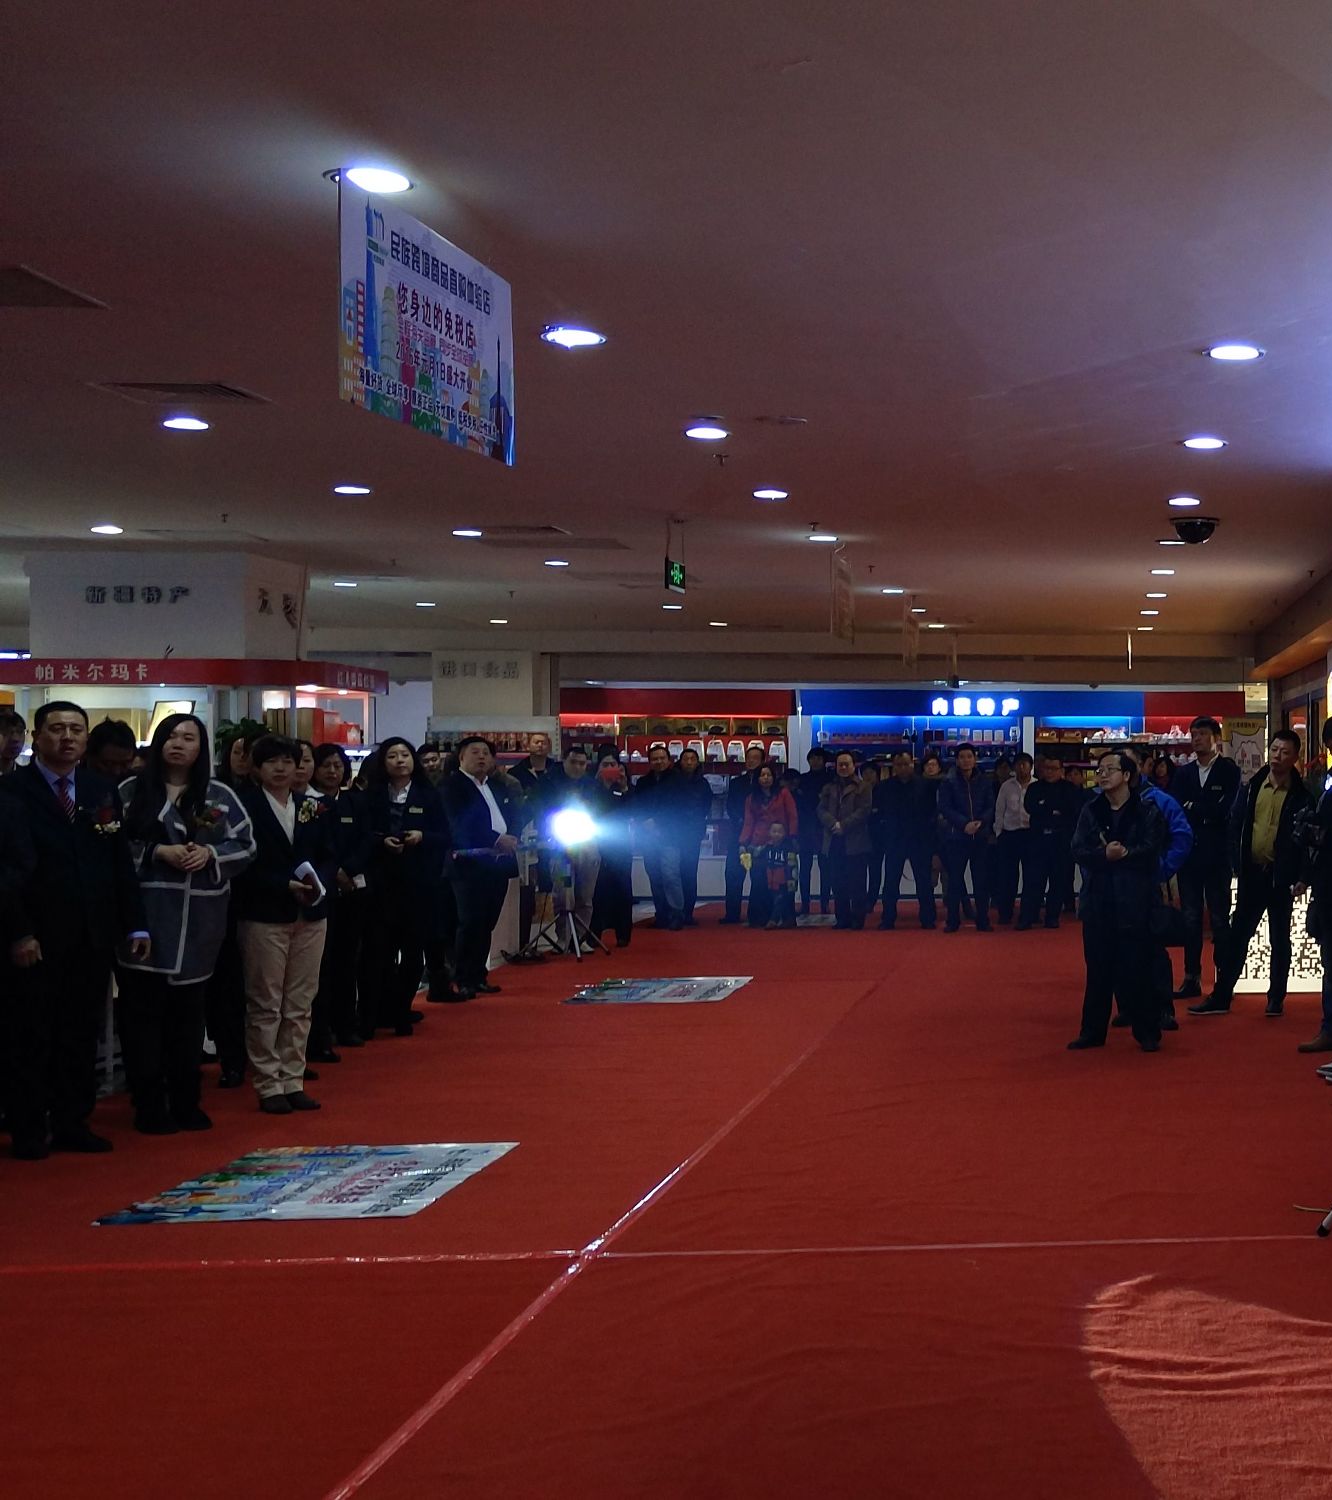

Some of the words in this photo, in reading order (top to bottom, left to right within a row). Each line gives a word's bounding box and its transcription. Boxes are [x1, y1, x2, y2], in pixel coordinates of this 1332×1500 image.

[396, 281, 475, 349] 您身边的免税店
[35, 664, 149, 681] 帕米尔玛卡
